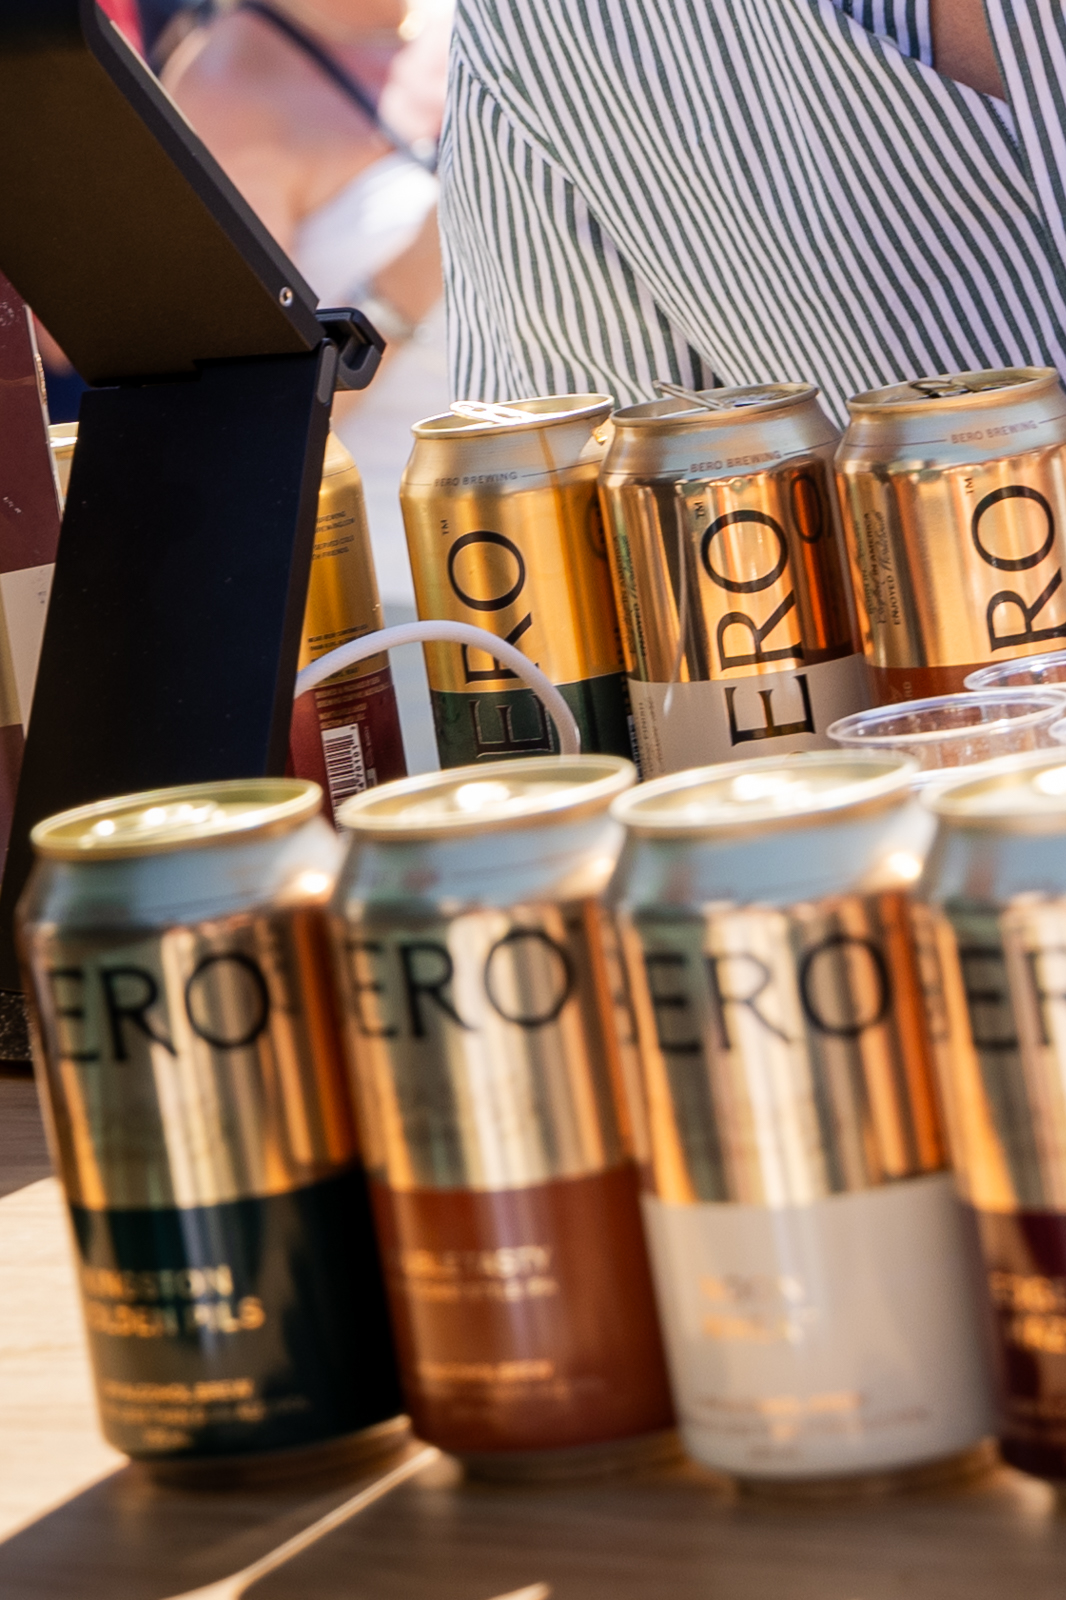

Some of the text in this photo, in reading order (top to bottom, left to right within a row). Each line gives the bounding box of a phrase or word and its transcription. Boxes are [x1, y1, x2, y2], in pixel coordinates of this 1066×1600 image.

[951, 420, 1038, 444] BERO BREWING
[690, 450, 782, 473] BERO BREWING
[462, 471, 519, 486] BREWING
